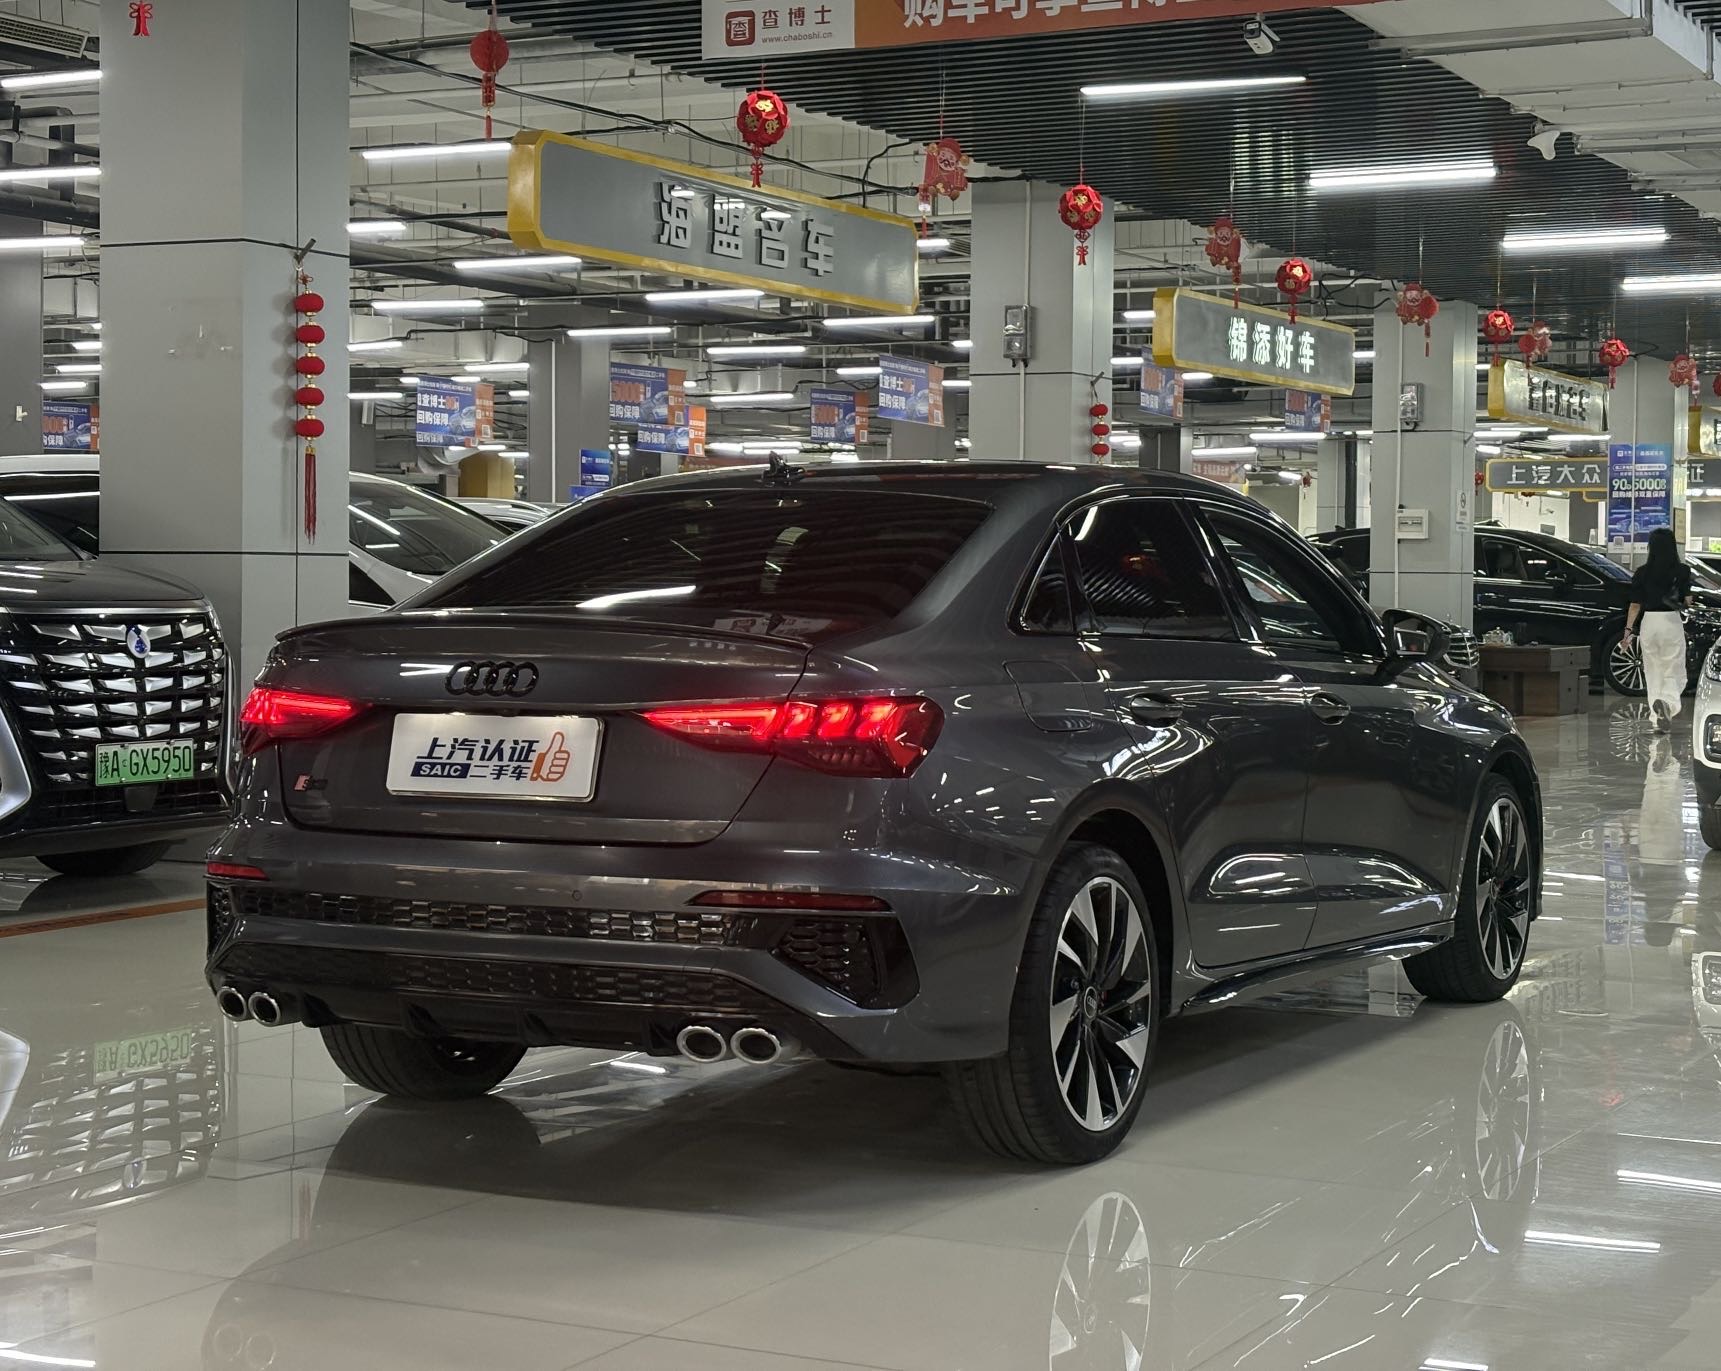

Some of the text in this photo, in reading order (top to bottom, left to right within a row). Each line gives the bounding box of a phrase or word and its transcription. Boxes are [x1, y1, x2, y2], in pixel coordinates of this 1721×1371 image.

[762, 5, 832, 30] 查博士
[761, 31, 833, 44] www.chaboshi.cn
[1229, 316, 1315, 373] 锦添好车
[879, 392, 906, 409] 回购保障
[417, 410, 449, 426] 回购保障
[609, 404, 640, 419] 回购保障
[811, 425, 836, 439] 回购保障
[1507, 464, 1601, 485] 上汽大众
[416, 737, 540, 763] 上汽认证
[419, 764, 463, 777] SAIC
[469, 764, 532, 781] 二手车
